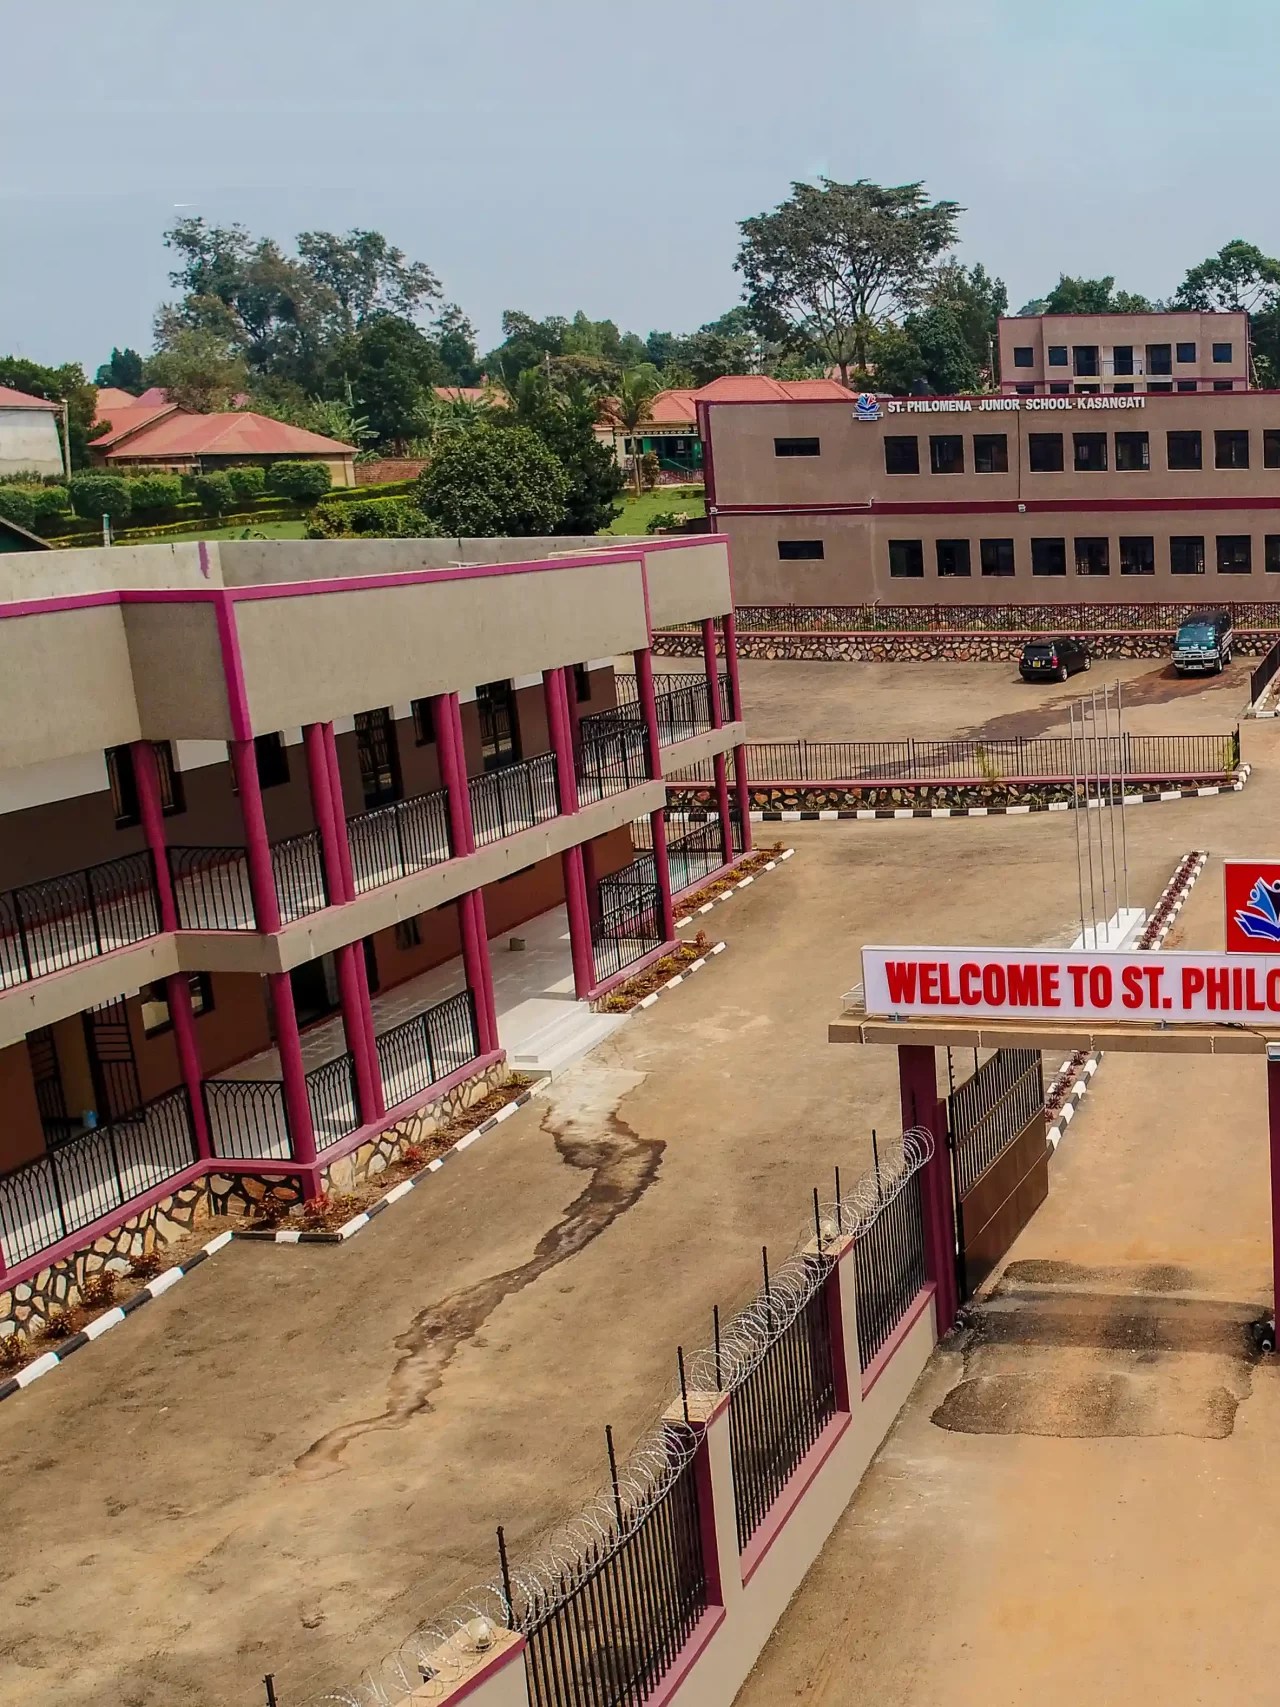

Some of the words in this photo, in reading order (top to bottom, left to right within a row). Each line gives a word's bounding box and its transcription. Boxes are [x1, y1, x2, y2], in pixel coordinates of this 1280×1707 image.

[887, 401, 905, 413] ST.
[907, 400, 972, 412] PHILOMENA
[978, 399, 1020, 411] JUNIOR
[885, 961, 1061, 1008] WELCOME
[1067, 964, 1113, 1008] TO
[1121, 965, 1173, 1009] ST.
